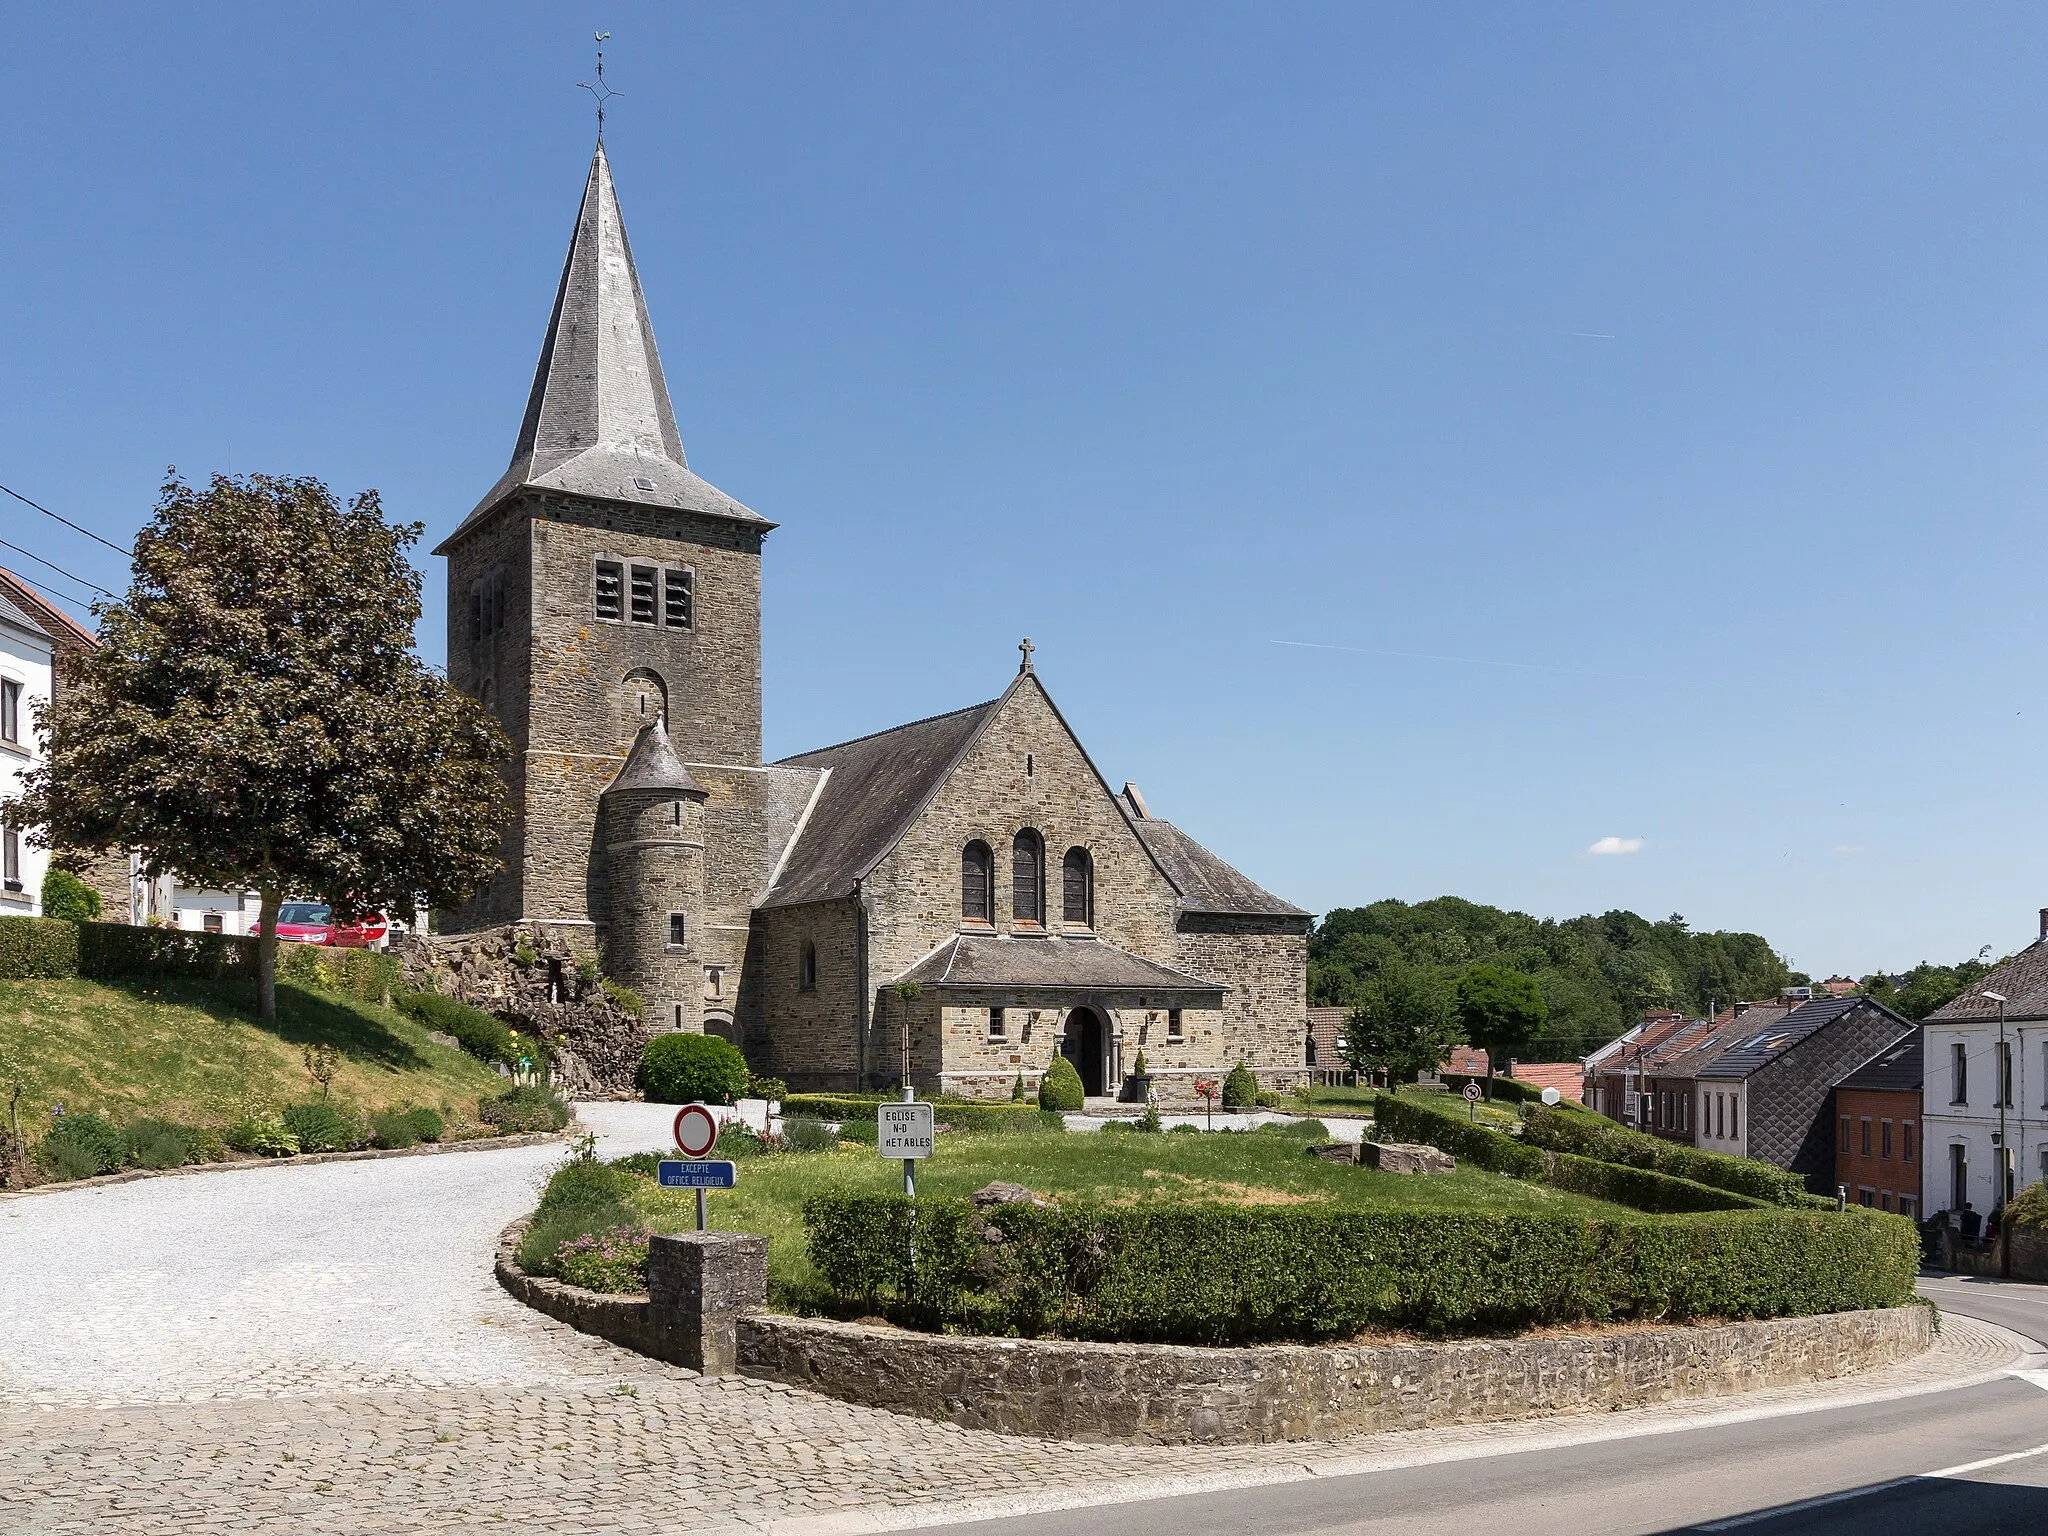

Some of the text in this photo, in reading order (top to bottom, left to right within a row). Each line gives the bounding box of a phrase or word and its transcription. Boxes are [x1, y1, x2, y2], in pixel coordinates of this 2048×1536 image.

[885, 1111, 916, 1121] EGLISE
[893, 1123, 907, 1133] N-D
[681, 1163, 710, 1174] EXCEPTE
[667, 1175, 725, 1186] OFFICE RELIGIEUX
